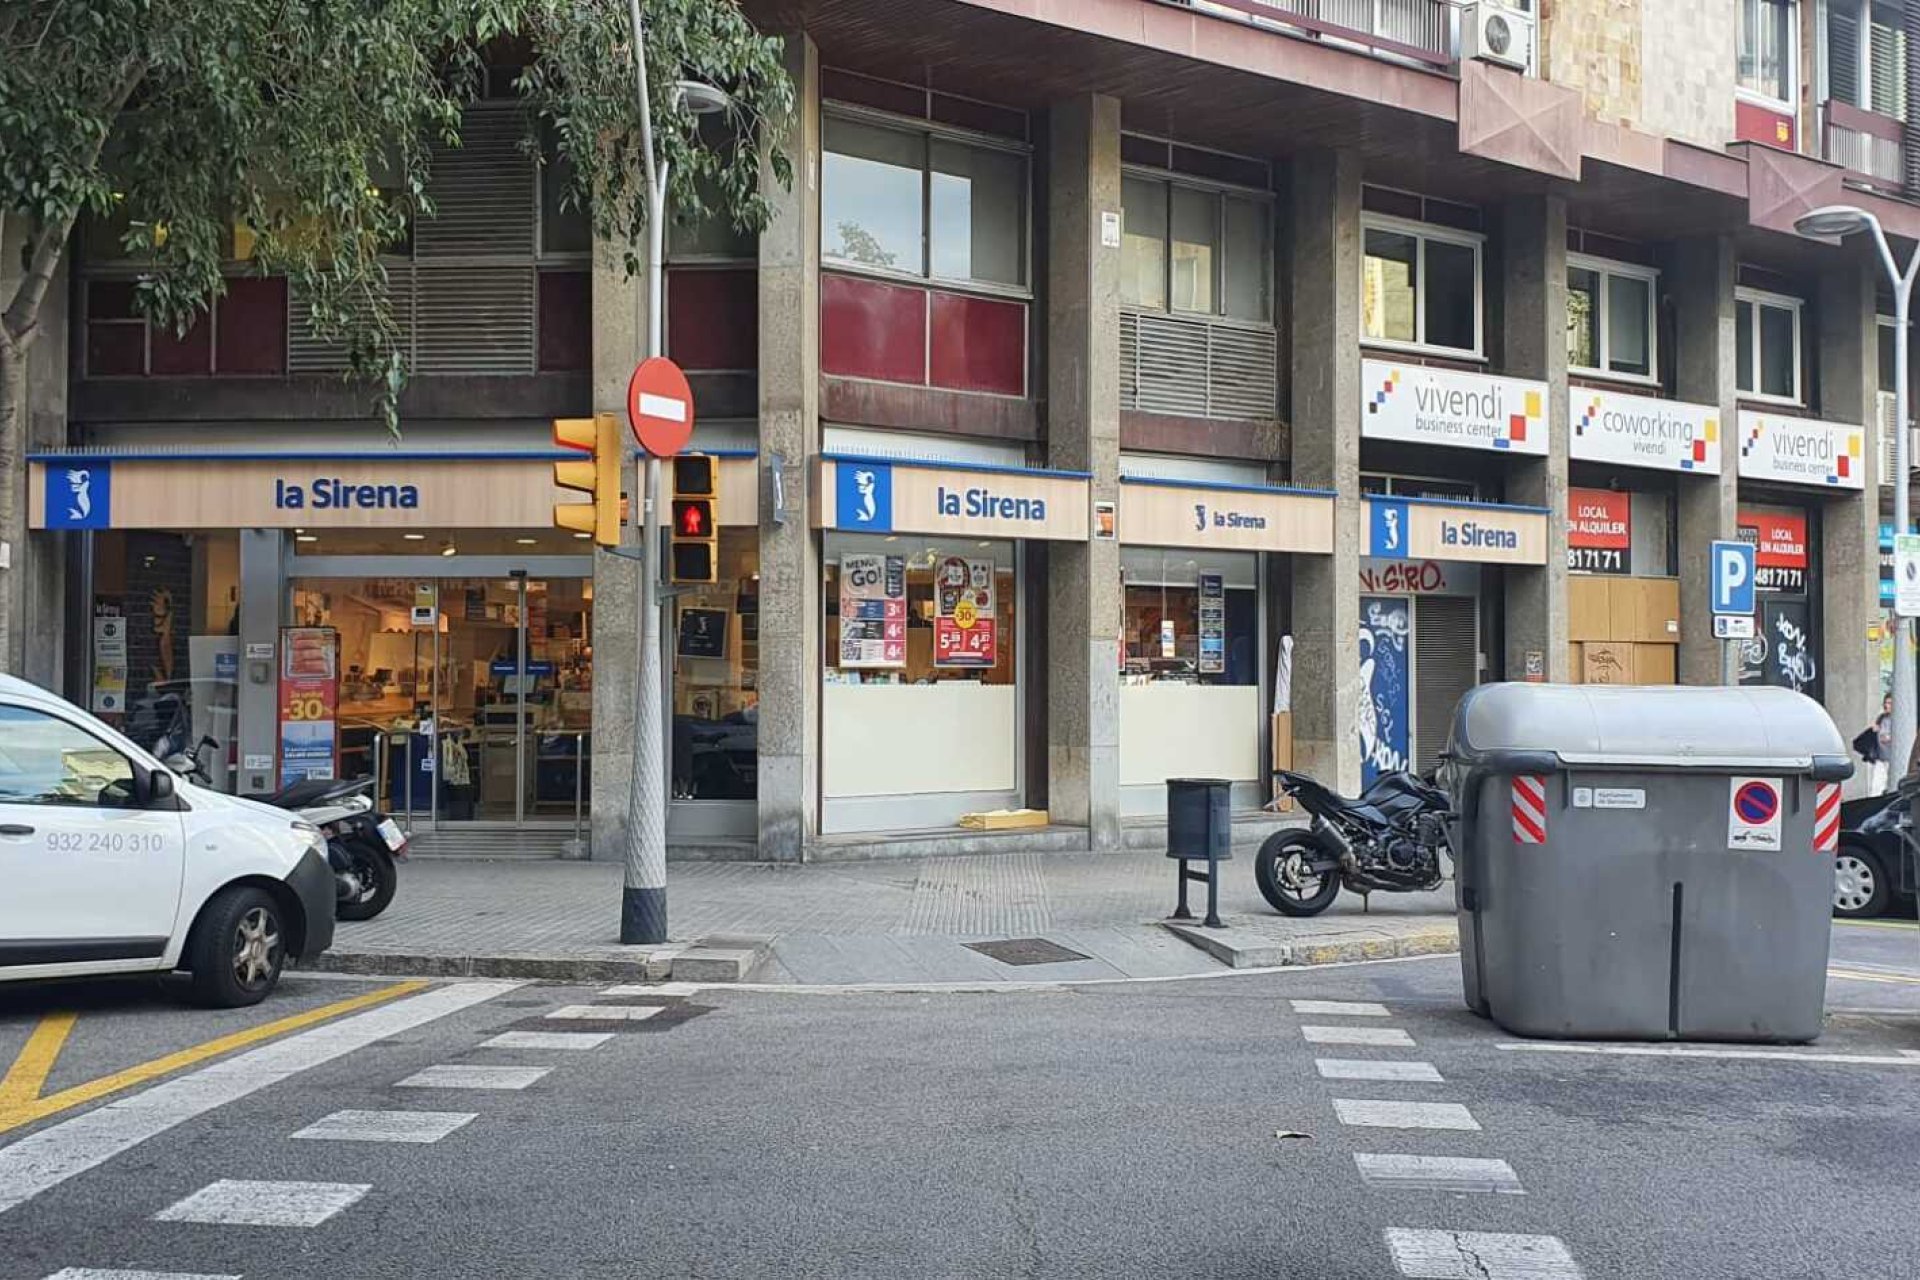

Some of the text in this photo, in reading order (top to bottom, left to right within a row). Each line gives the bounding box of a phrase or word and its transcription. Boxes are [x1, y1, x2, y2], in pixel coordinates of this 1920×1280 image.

[1415, 377, 1502, 421] vivendi
[1415, 415, 1502, 438] business center
[1603, 410, 1694, 449] coworking
[1633, 436, 1667, 455] vivendi
[1773, 424, 1834, 460] vivendi
[1773, 456, 1834, 475] business center
[276, 477, 419, 509] la Sirena
[937, 486, 1046, 521] la Sirena
[1213, 511, 1266, 530] la Sirena
[1577, 504, 1609, 519] LOCAL
[1441, 520, 1517, 549] la Sirena
[1579, 519, 1627, 536] ALQUILER
[1771, 527, 1793, 541] LOCAL
[1720, 550, 1748, 606] P
[46, 832, 163, 851] 932 240 310
